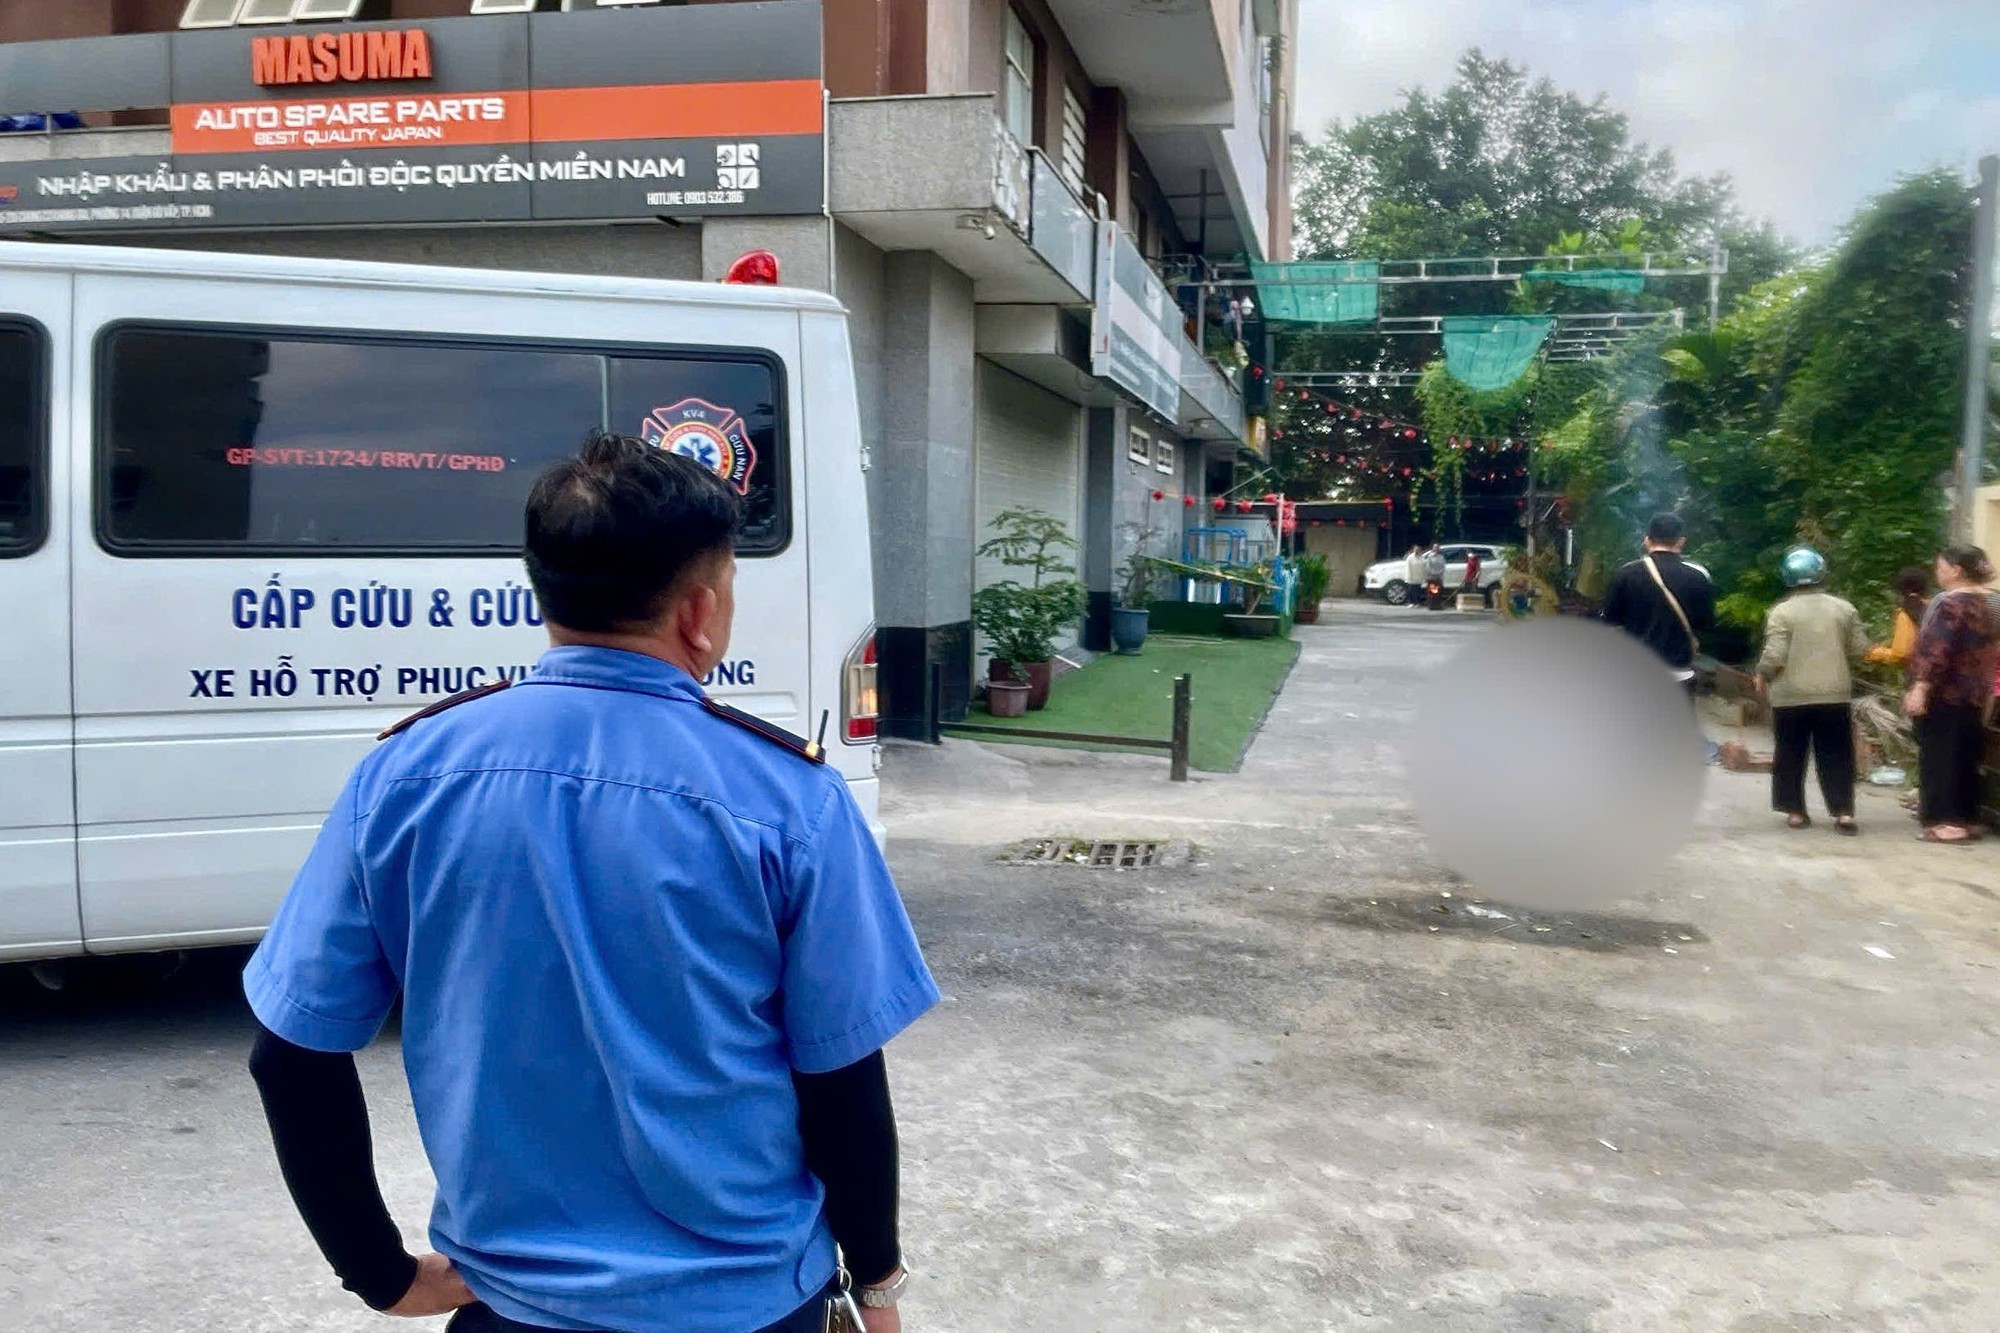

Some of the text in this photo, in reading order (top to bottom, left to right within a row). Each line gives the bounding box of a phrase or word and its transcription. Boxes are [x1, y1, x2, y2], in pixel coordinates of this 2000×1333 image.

[252, 29, 432, 85] MASUMA
[195, 98, 505, 130] AUTO SPARE PARTS
[254, 126, 442, 146] BEST QUALITY JAPAN
[38, 171, 111, 201] NHẬP
[114, 162, 187, 193] KHẨU
[192, 172, 213, 191] &
[217, 165, 293, 189] PHÂN
[369, 159, 430, 192] ĐỘC
[436, 154, 535, 188] QUYỀN
[540, 151, 613, 181] MIỀN
[617, 158, 686, 178] NAM
[232, 573, 315, 629] CẤP
[331, 580, 413, 628] CỨU
[428, 588, 455, 627] &
[189, 670, 234, 697] XE
[250, 655, 297, 697] HỖ
[310, 664, 382, 702] TRỢ
